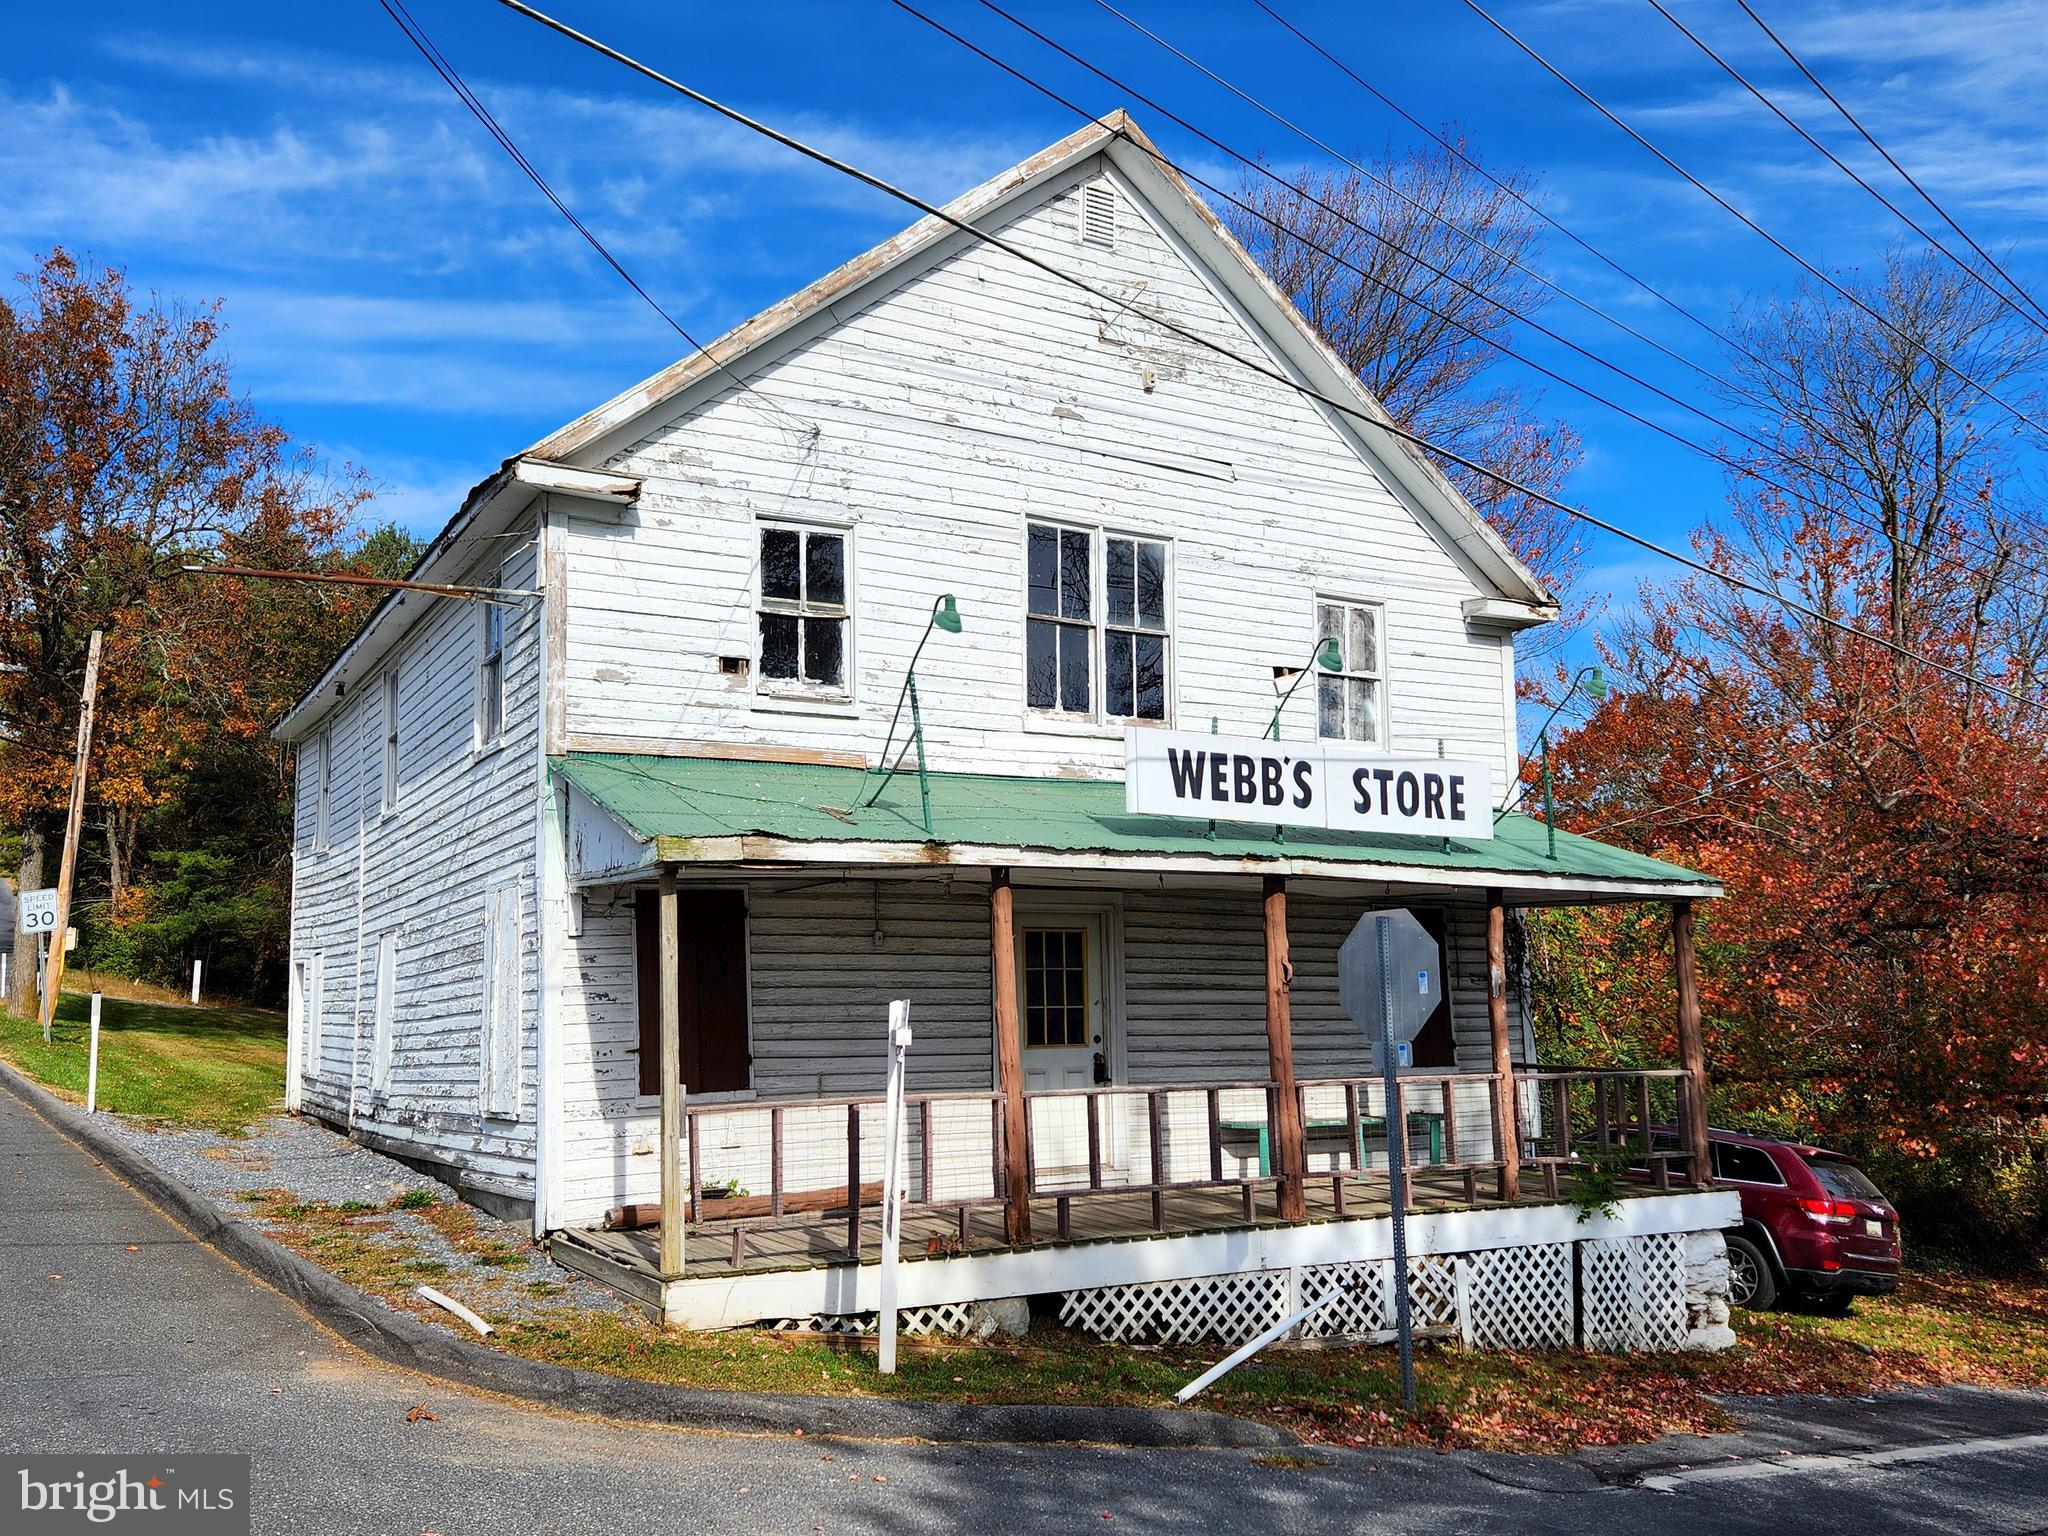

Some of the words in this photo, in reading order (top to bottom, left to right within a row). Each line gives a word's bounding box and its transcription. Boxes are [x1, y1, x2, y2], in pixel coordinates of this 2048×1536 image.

[1167, 747, 1312, 810] WEBB'S
[1352, 766, 1466, 821] STORE
[24, 894, 54, 903] SPEED
[27, 903, 50, 911] LIMIT
[26, 911, 54, 928] 30
